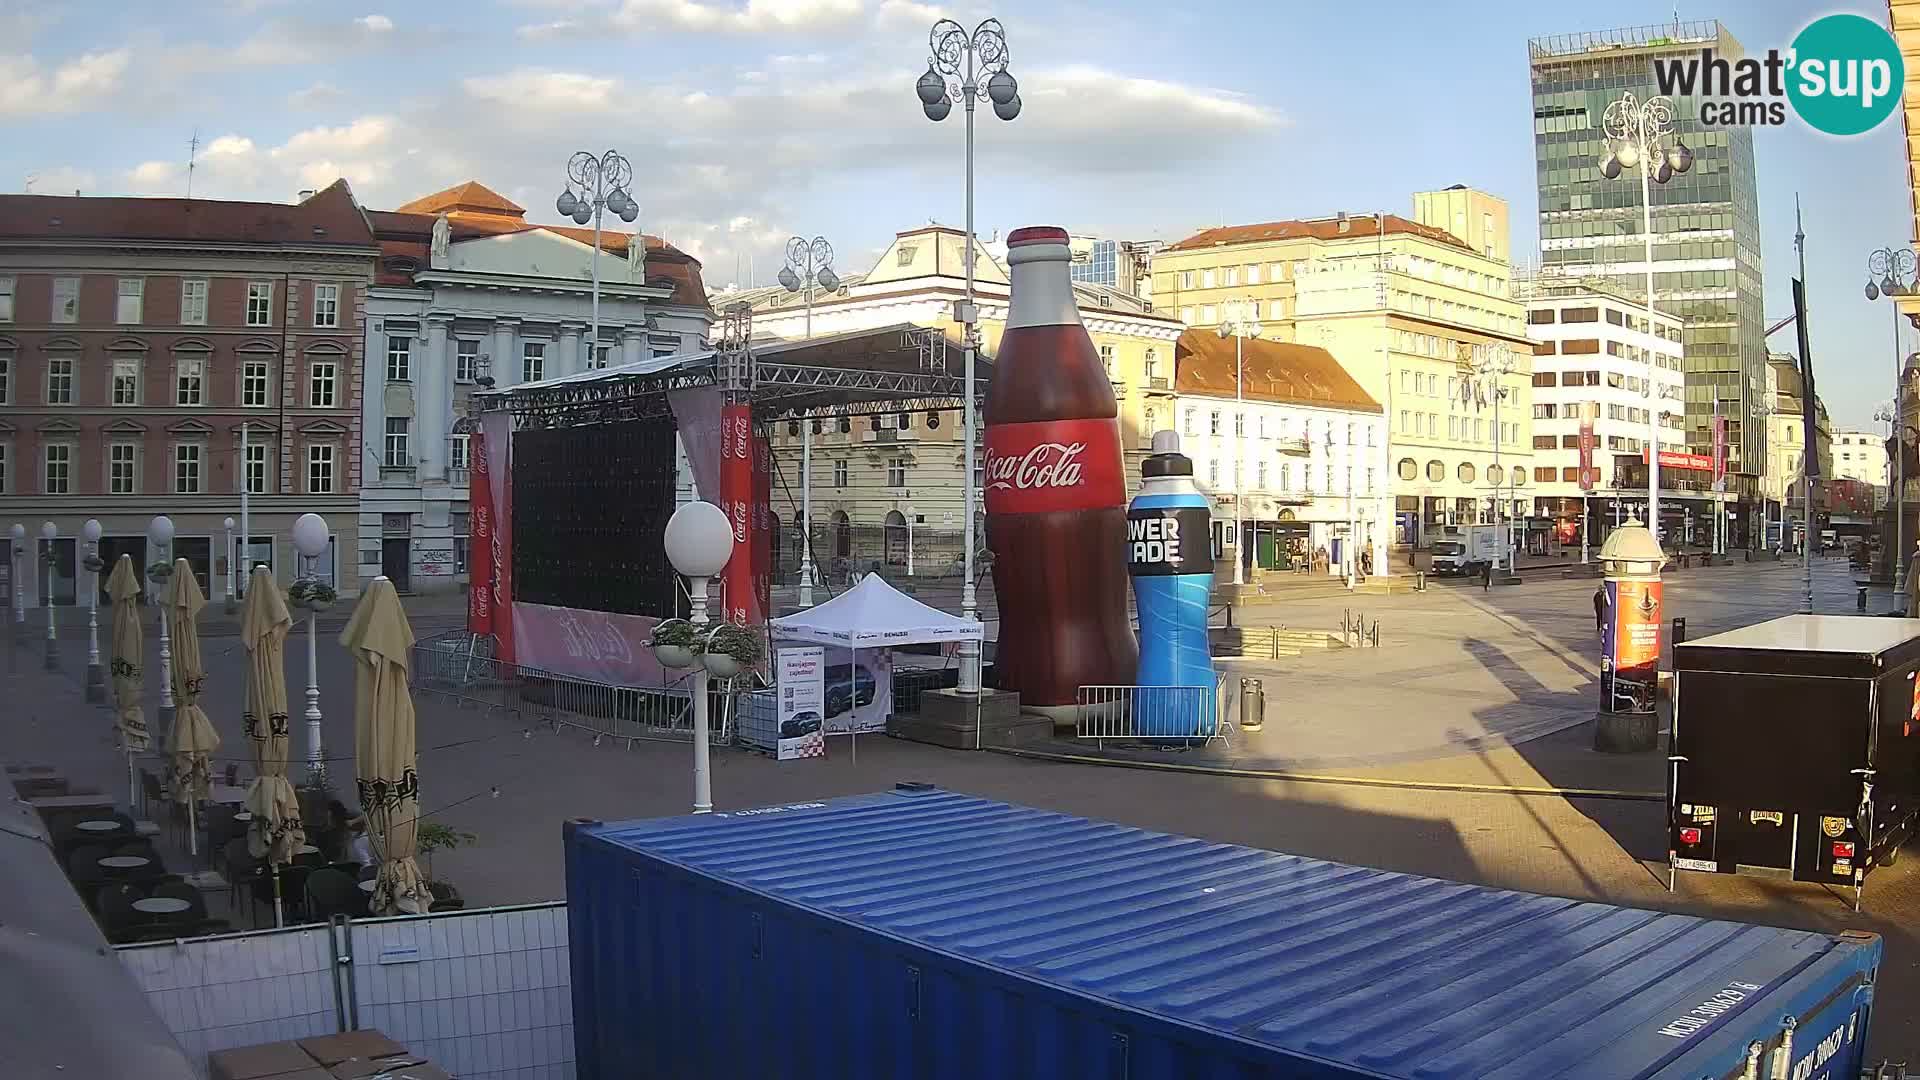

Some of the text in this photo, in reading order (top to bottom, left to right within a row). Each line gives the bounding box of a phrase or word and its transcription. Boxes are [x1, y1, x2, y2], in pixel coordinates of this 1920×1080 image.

[735, 416, 747, 460] Coca-Cola
[984, 441, 1088, 491] Coca-Cola
[734, 501, 746, 544] Coca-Cola
[1127, 518, 1180, 541] WER
[1657, 1015, 1709, 1038] MCDU
[1690, 989, 1747, 1018] 300629
